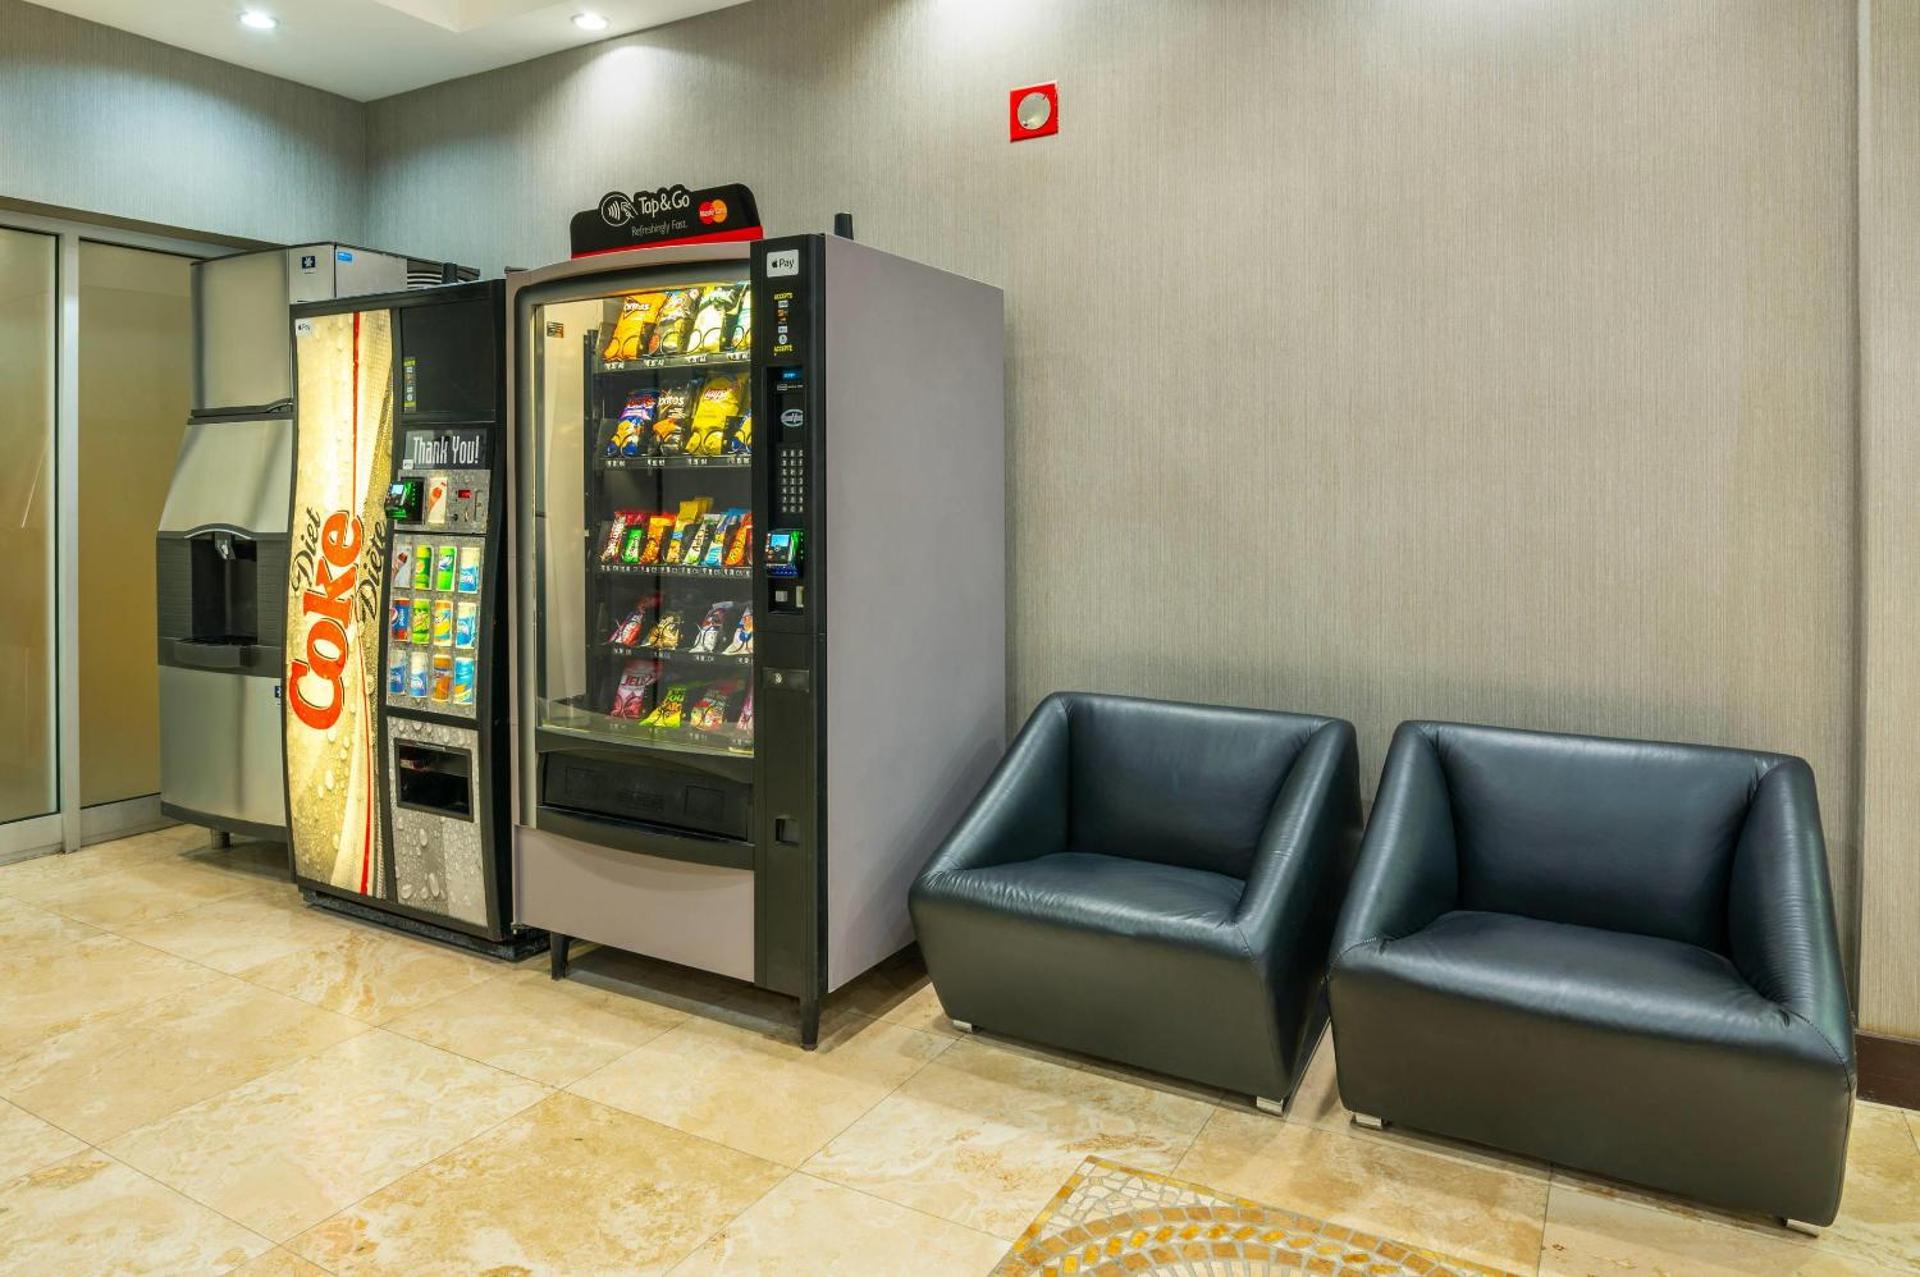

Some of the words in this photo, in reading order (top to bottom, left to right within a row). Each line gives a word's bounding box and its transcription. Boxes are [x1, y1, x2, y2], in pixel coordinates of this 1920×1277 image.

[638, 190, 690, 218] Tap&Go
[631, 221, 671, 238] Refreshingly
[779, 258, 795, 269] Pay
[413, 434, 448, 465] Thank
[452, 434, 480, 465] You!
[291, 507, 321, 592] Diet
[355, 521, 388, 624] Diète
[288, 510, 364, 729] Coke
